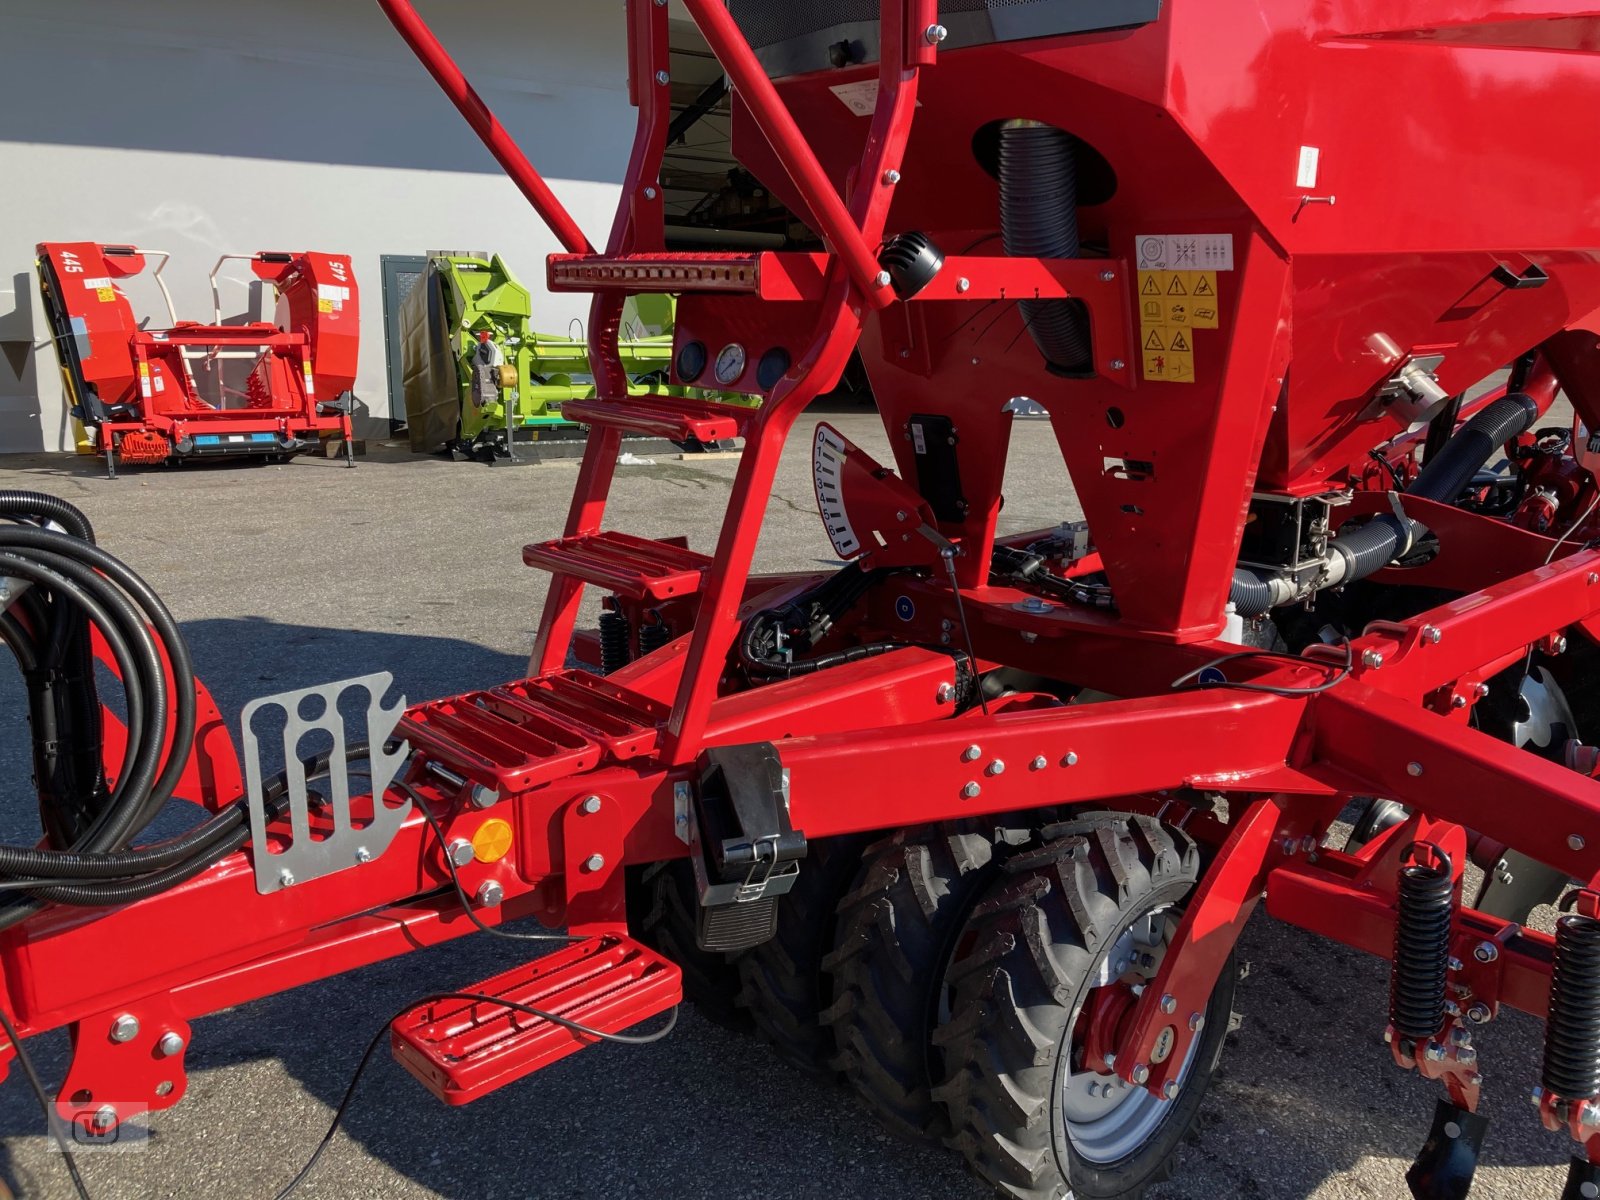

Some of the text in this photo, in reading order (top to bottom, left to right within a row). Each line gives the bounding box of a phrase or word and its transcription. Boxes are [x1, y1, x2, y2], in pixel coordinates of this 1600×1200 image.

[60, 251, 84, 273] 445
[328, 261, 348, 282] 445
[818, 431, 825, 441] 0
[817, 447, 822, 456] 1
[815, 461, 822, 472] 2
[817, 478, 823, 489] 3
[820, 493, 826, 504] 4
[823, 509, 830, 520] 5
[828, 525, 836, 537] 6
[835, 541, 843, 552] 7
